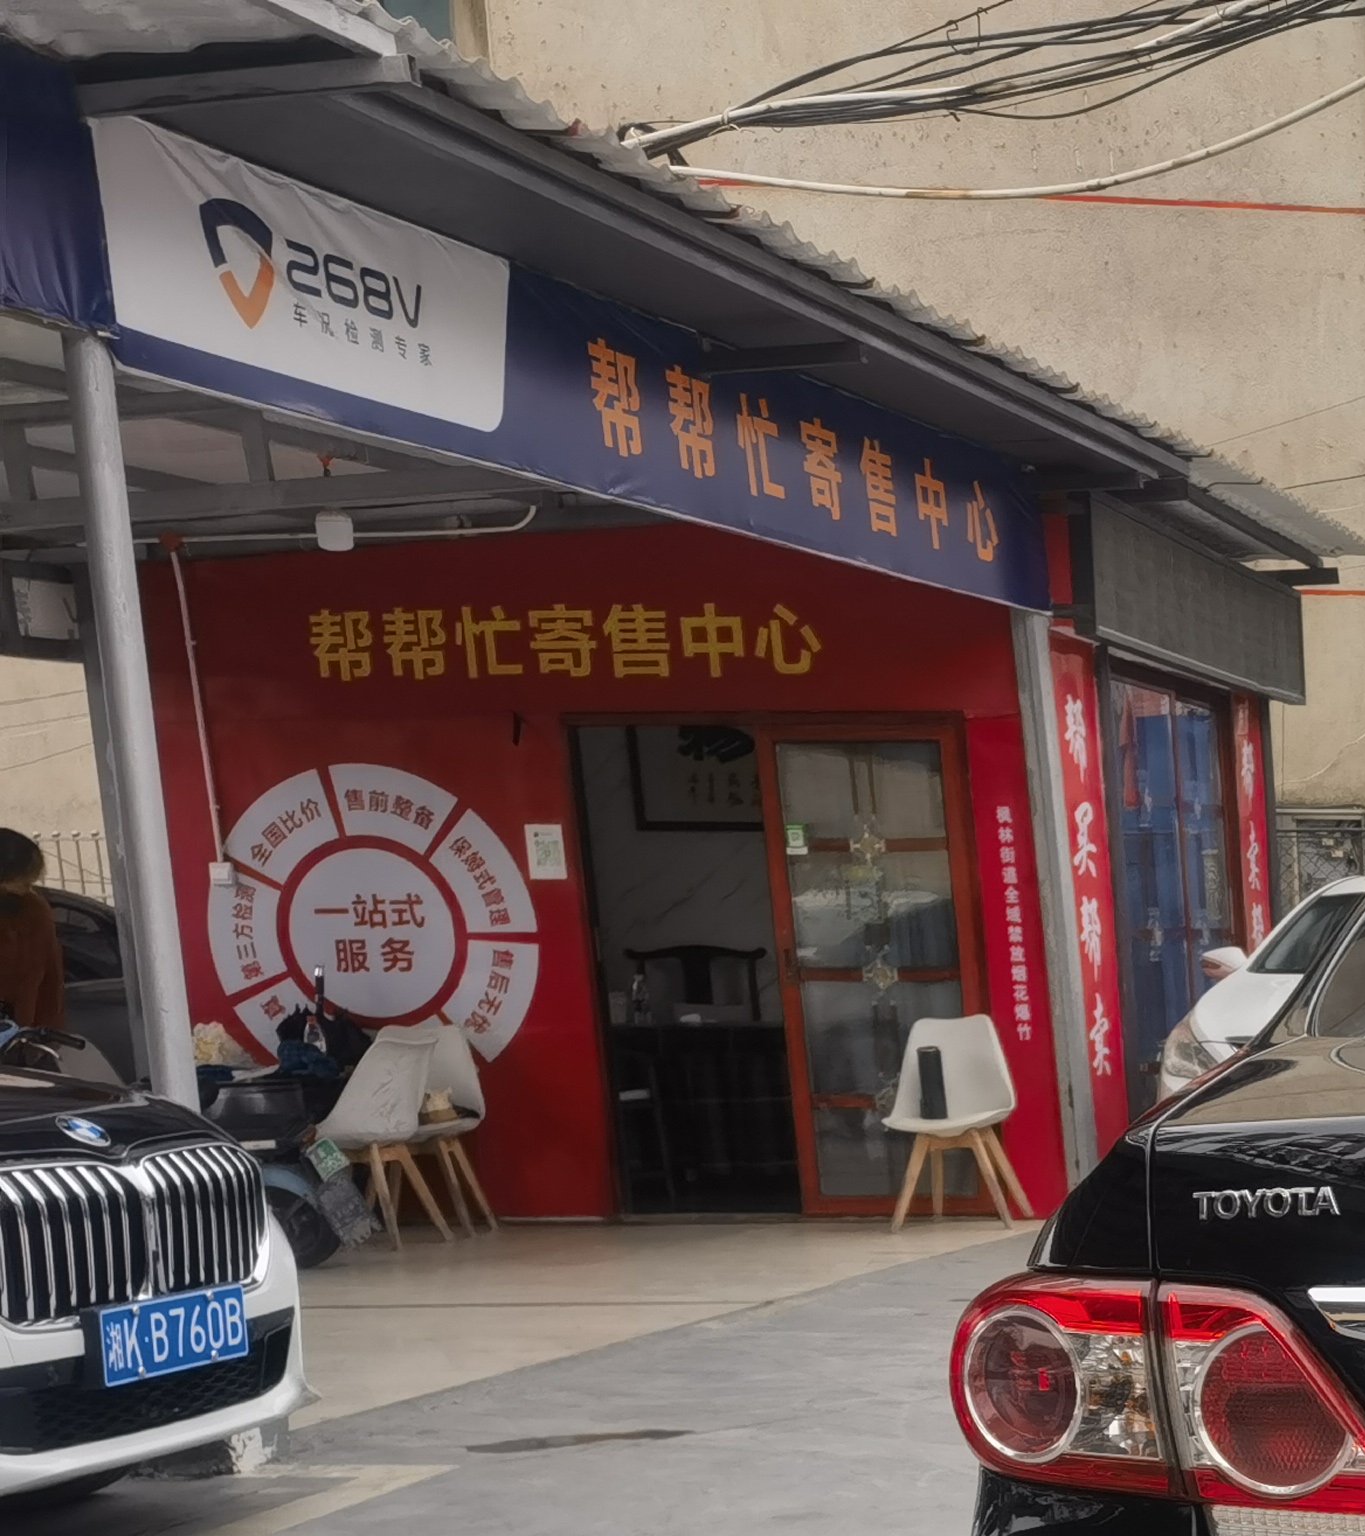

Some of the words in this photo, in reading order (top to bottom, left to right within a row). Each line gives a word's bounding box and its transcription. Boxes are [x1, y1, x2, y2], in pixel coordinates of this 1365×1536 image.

[285, 238, 422, 328] 268V
[587, 338, 999, 562] 帮帮忙寄售中心
[309, 603, 822, 681] 帮帮忙寄售中心
[250, 798, 322, 867] 全国比价
[344, 789, 436, 831] 售前整备
[314, 893, 426, 929] 一站式
[335, 939, 415, 974] 服务
[1192, 1185, 1341, 1221] TOYOTA
